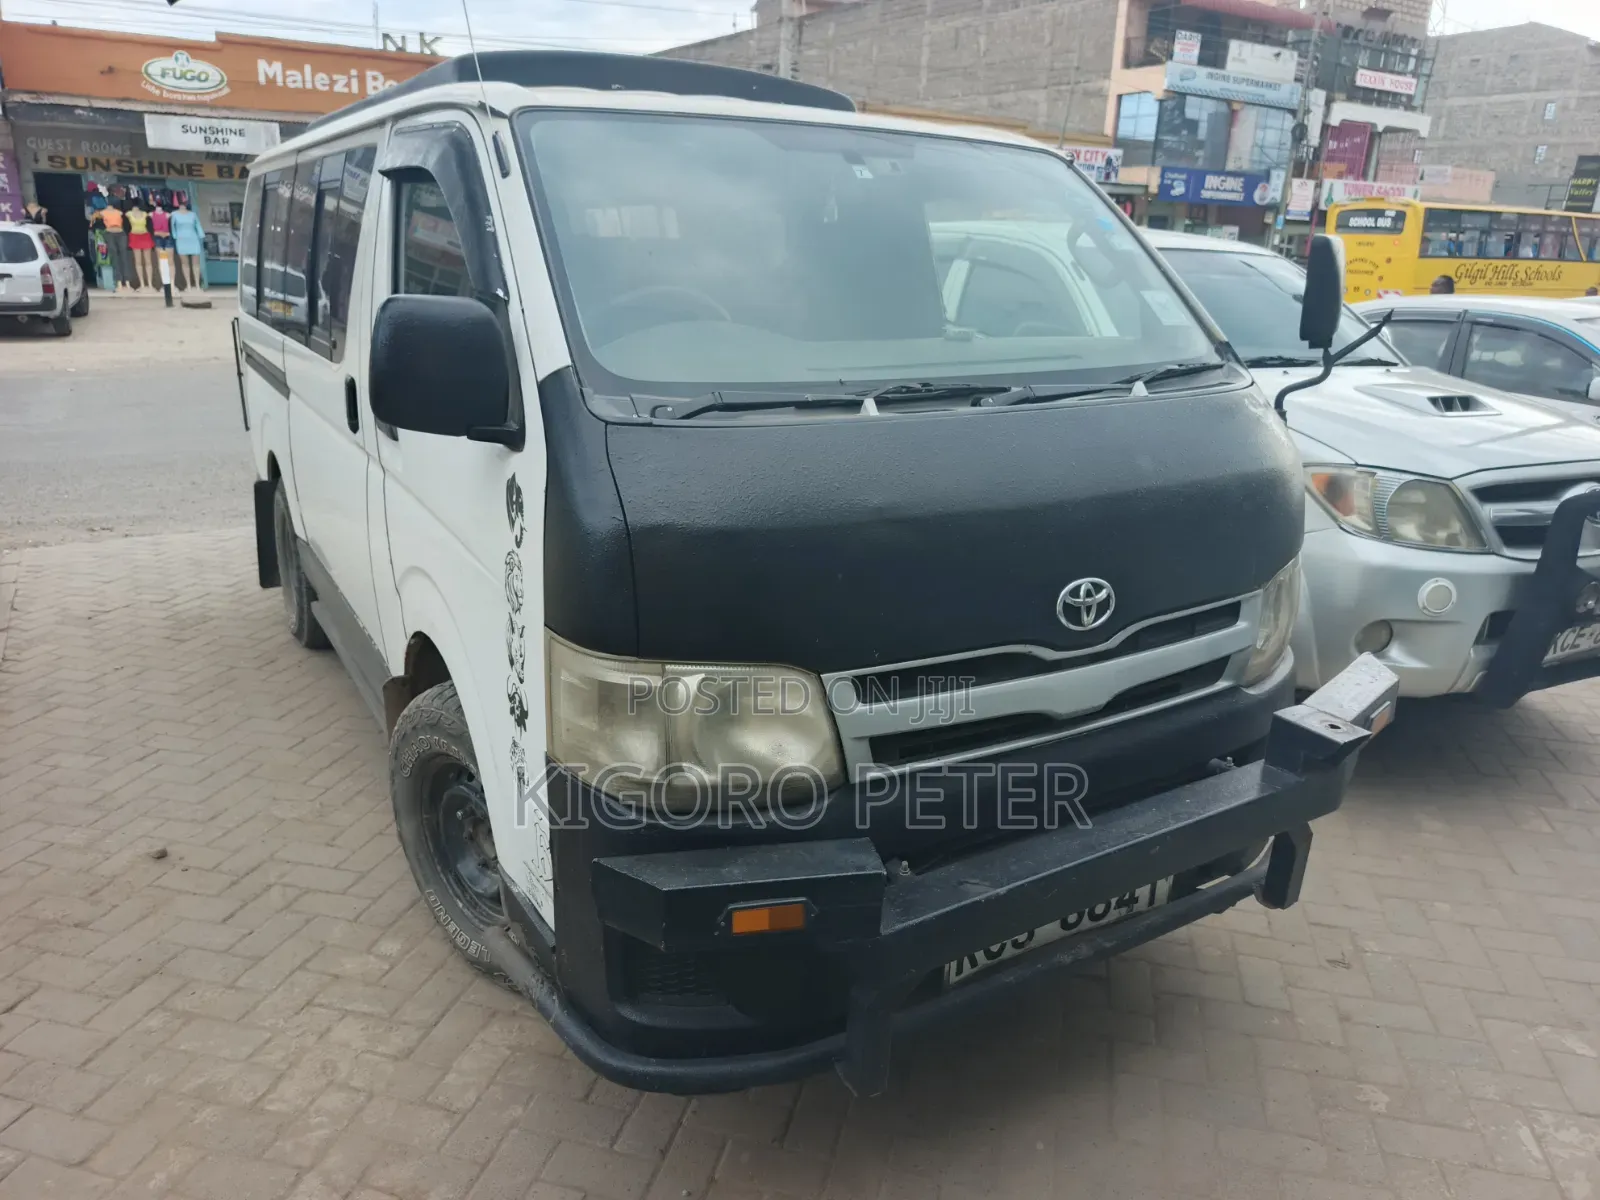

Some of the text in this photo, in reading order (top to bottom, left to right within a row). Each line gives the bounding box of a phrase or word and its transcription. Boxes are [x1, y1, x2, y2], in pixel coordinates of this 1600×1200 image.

[160, 67, 209, 83] FUGO
[257, 58, 359, 94] Malezi
[365, 70, 400, 96] Bo
[181, 124, 246, 137] SUNSHINE
[81, 140, 132, 156] ROOMS
[203, 136, 230, 146] BAR
[1083, 150, 1108, 162] CITY
[47, 155, 205, 178] SUNSHINE
[217, 164, 250, 179] BA
[1204, 174, 1245, 192] INGINE
[1348, 217, 1392, 228] SCHOOL BUS
[1454, 262, 1563, 285] Gilgil Hills Schools
[425, 889, 492, 963] LEGEND
